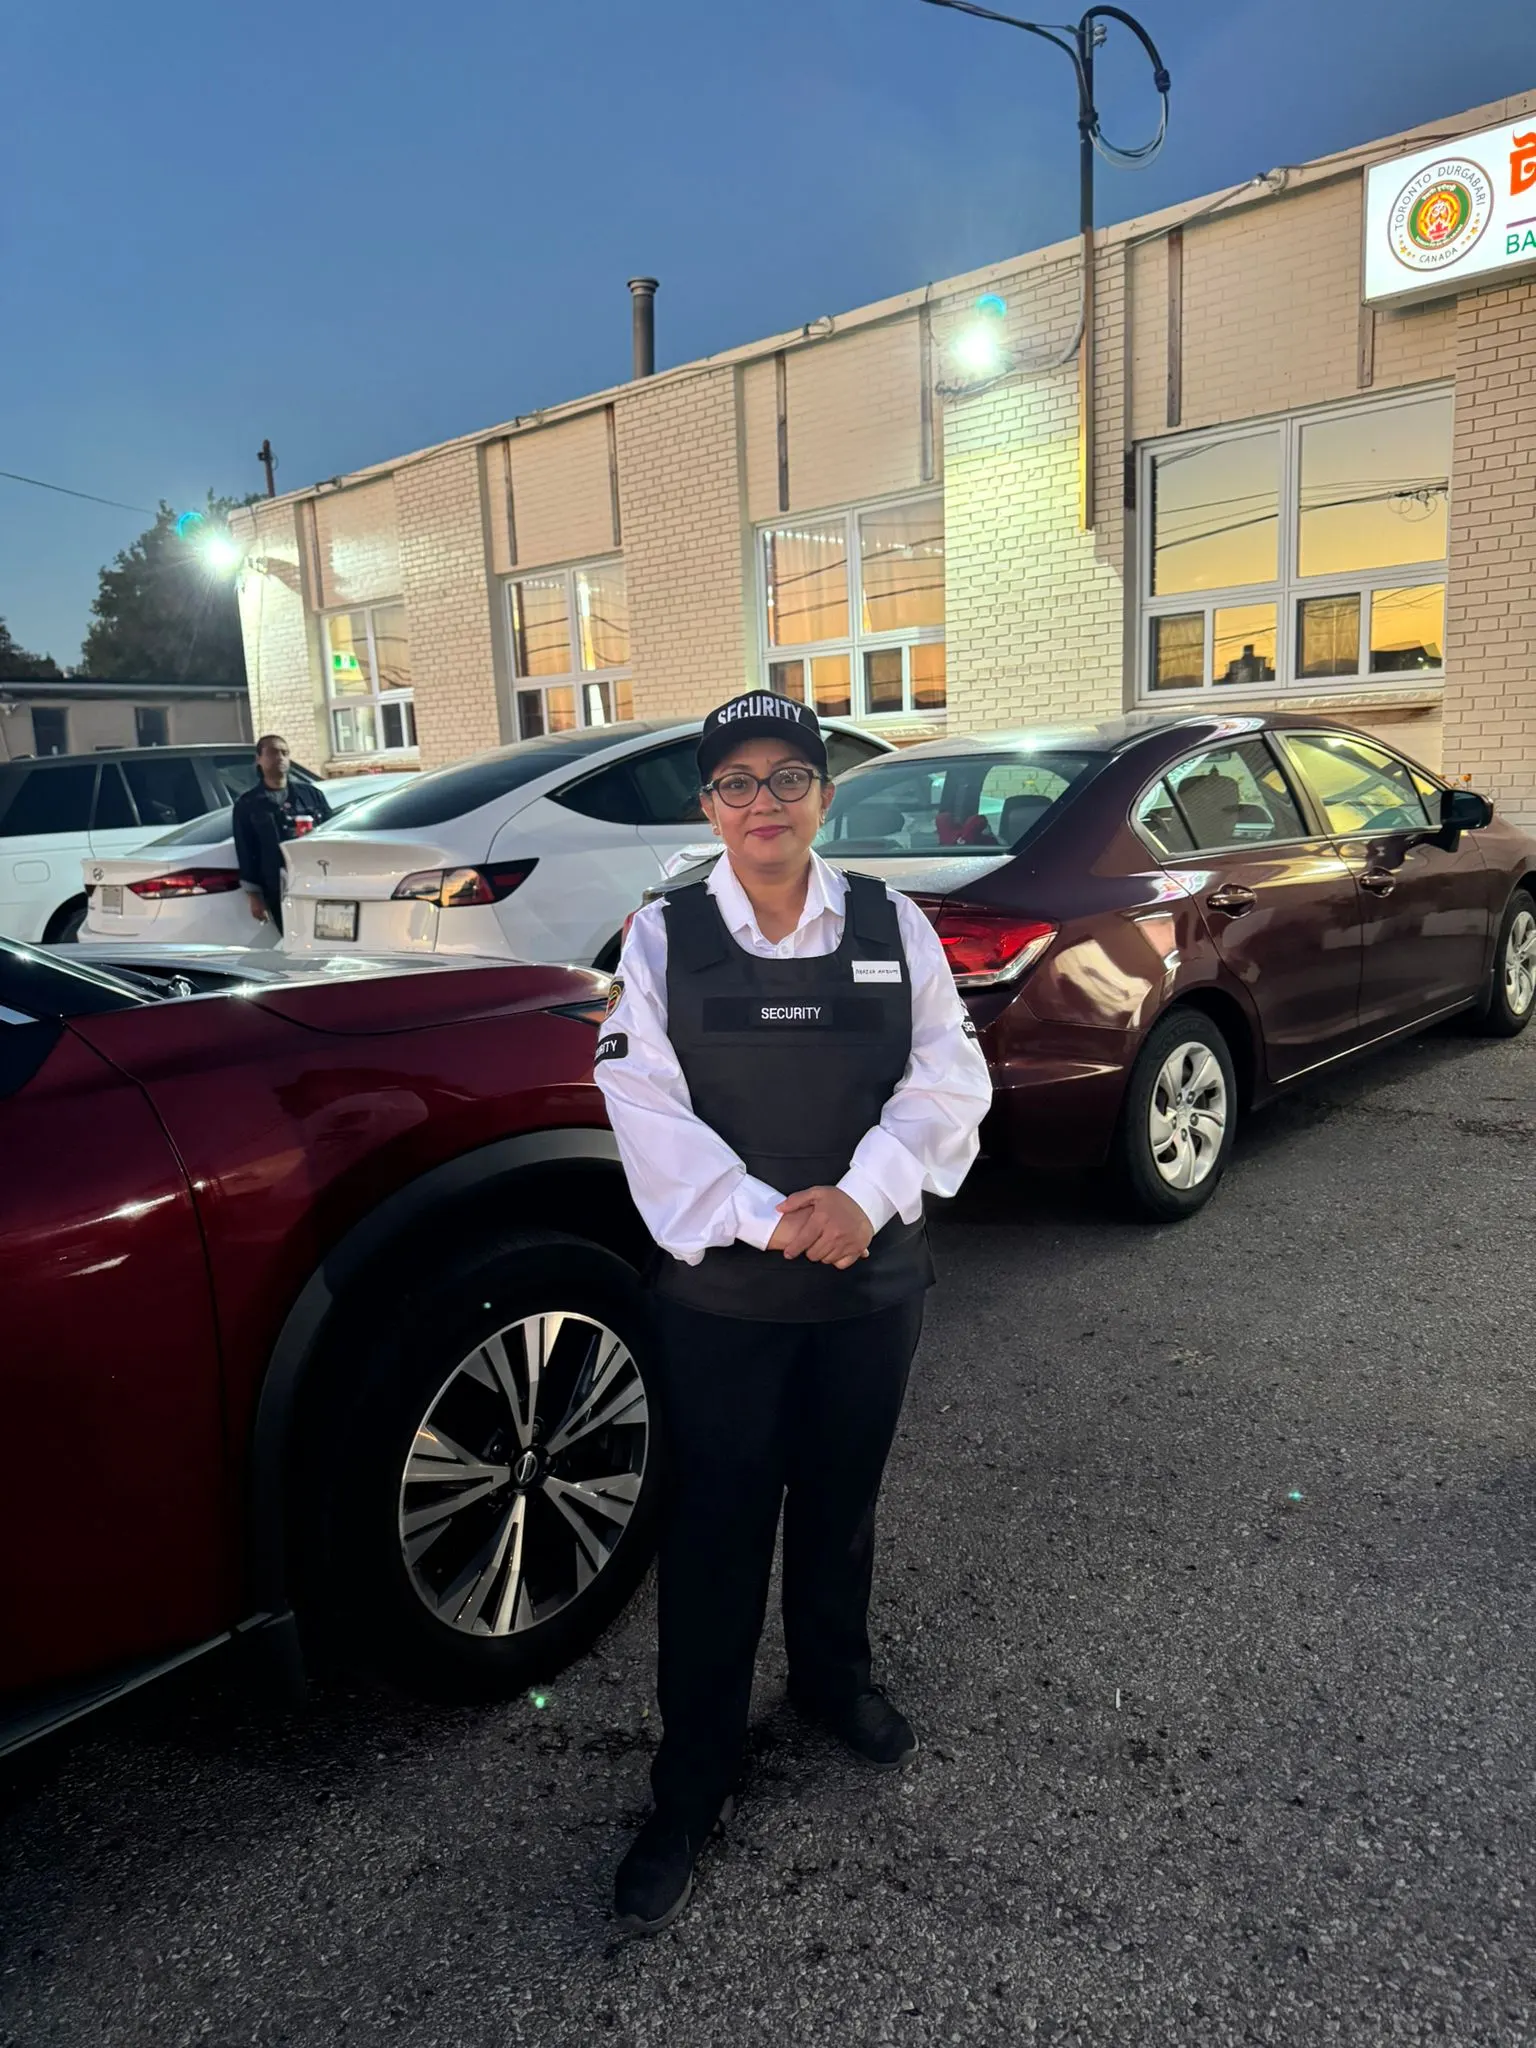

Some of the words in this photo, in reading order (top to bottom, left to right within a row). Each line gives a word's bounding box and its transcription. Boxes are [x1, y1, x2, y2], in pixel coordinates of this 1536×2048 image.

[1394, 173, 1432, 232] TORONTO
[1437, 165, 1486, 206] DURGABARI
[1419, 247, 1458, 264] CANADA
[717, 695, 802, 725] SECURITY
[760, 1006, 822, 1020] SECURITY
